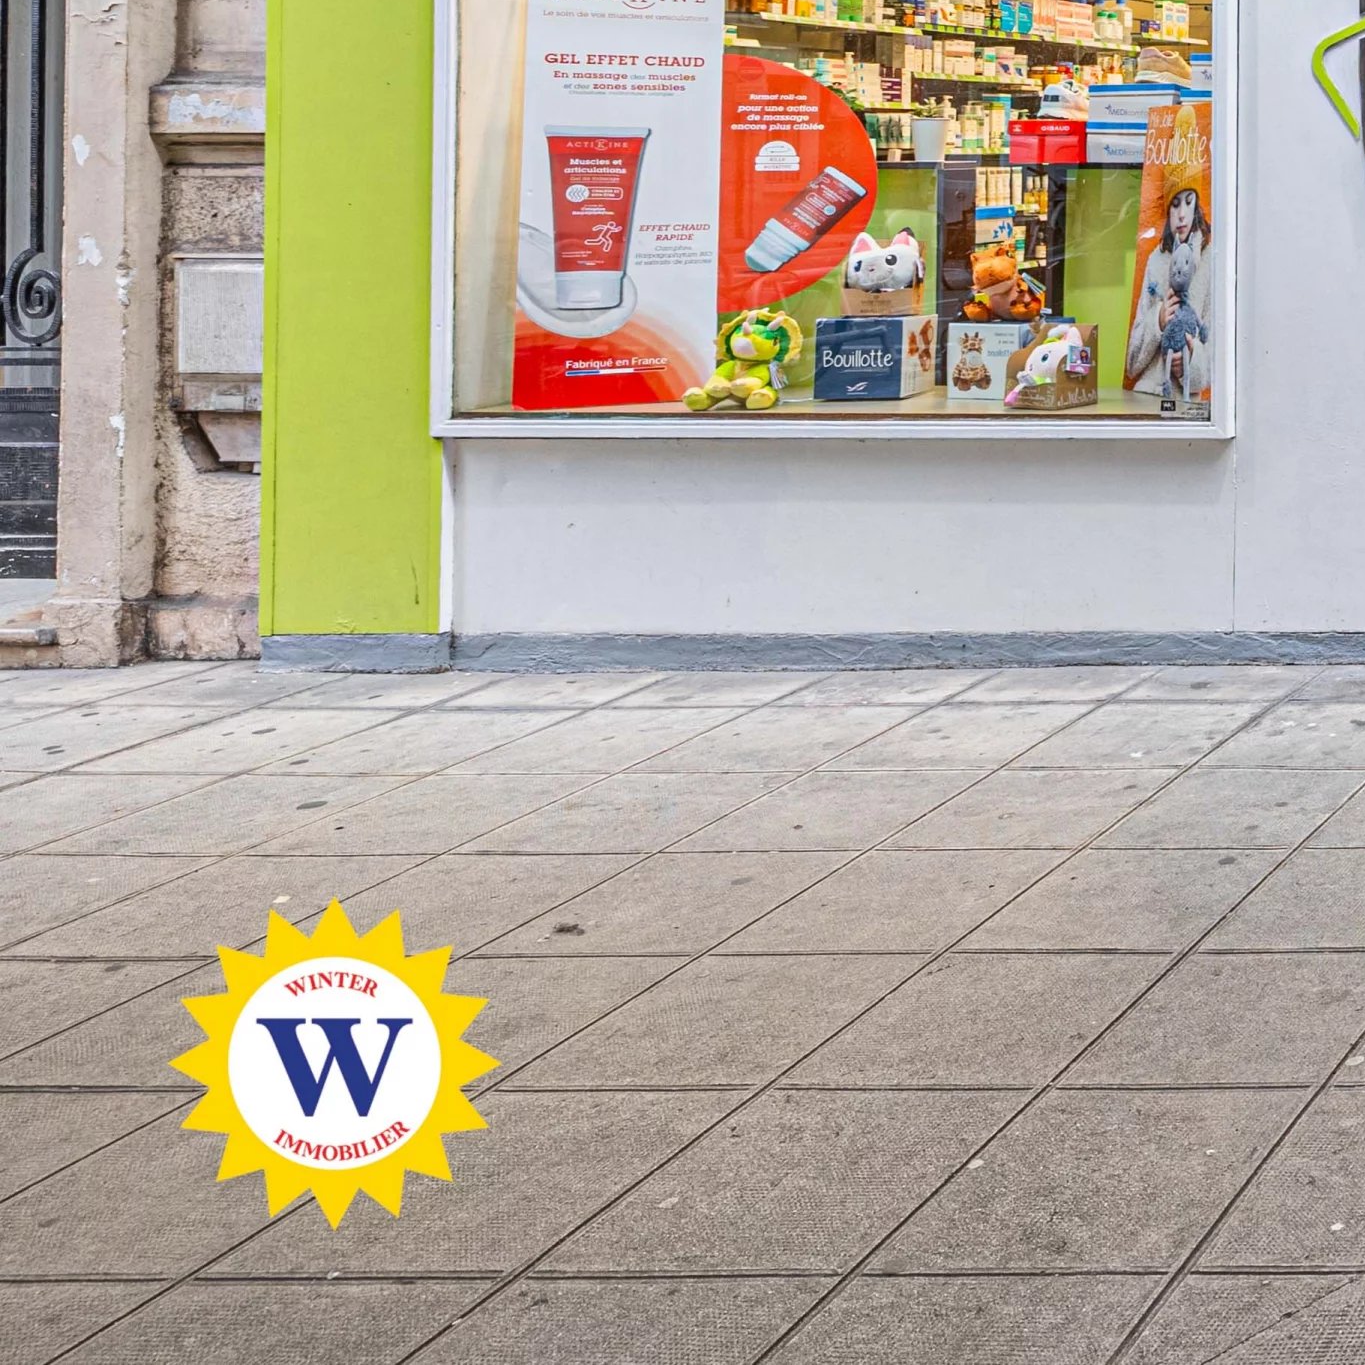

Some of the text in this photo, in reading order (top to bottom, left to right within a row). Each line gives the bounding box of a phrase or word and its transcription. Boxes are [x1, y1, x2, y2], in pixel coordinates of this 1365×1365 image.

[544, 53, 705, 68] GEL EFFET CHAUD
[553, 70, 569, 79] En
[573, 72, 628, 81] massage
[648, 73, 696, 81] muscles
[592, 83, 627, 91] zones
[630, 83, 686, 92] sensibles
[737, 105, 762, 113] pour
[786, 104, 819, 112] action
[763, 114, 809, 123] massage
[769, 123, 791, 132] plus
[793, 122, 824, 130] ciblée
[1145, 128, 1207, 164] Bouillotte
[639, 224, 671, 232] EFFET
[565, 356, 667, 370] Fabriqué en France
[823, 350, 894, 367] Bouillotte
